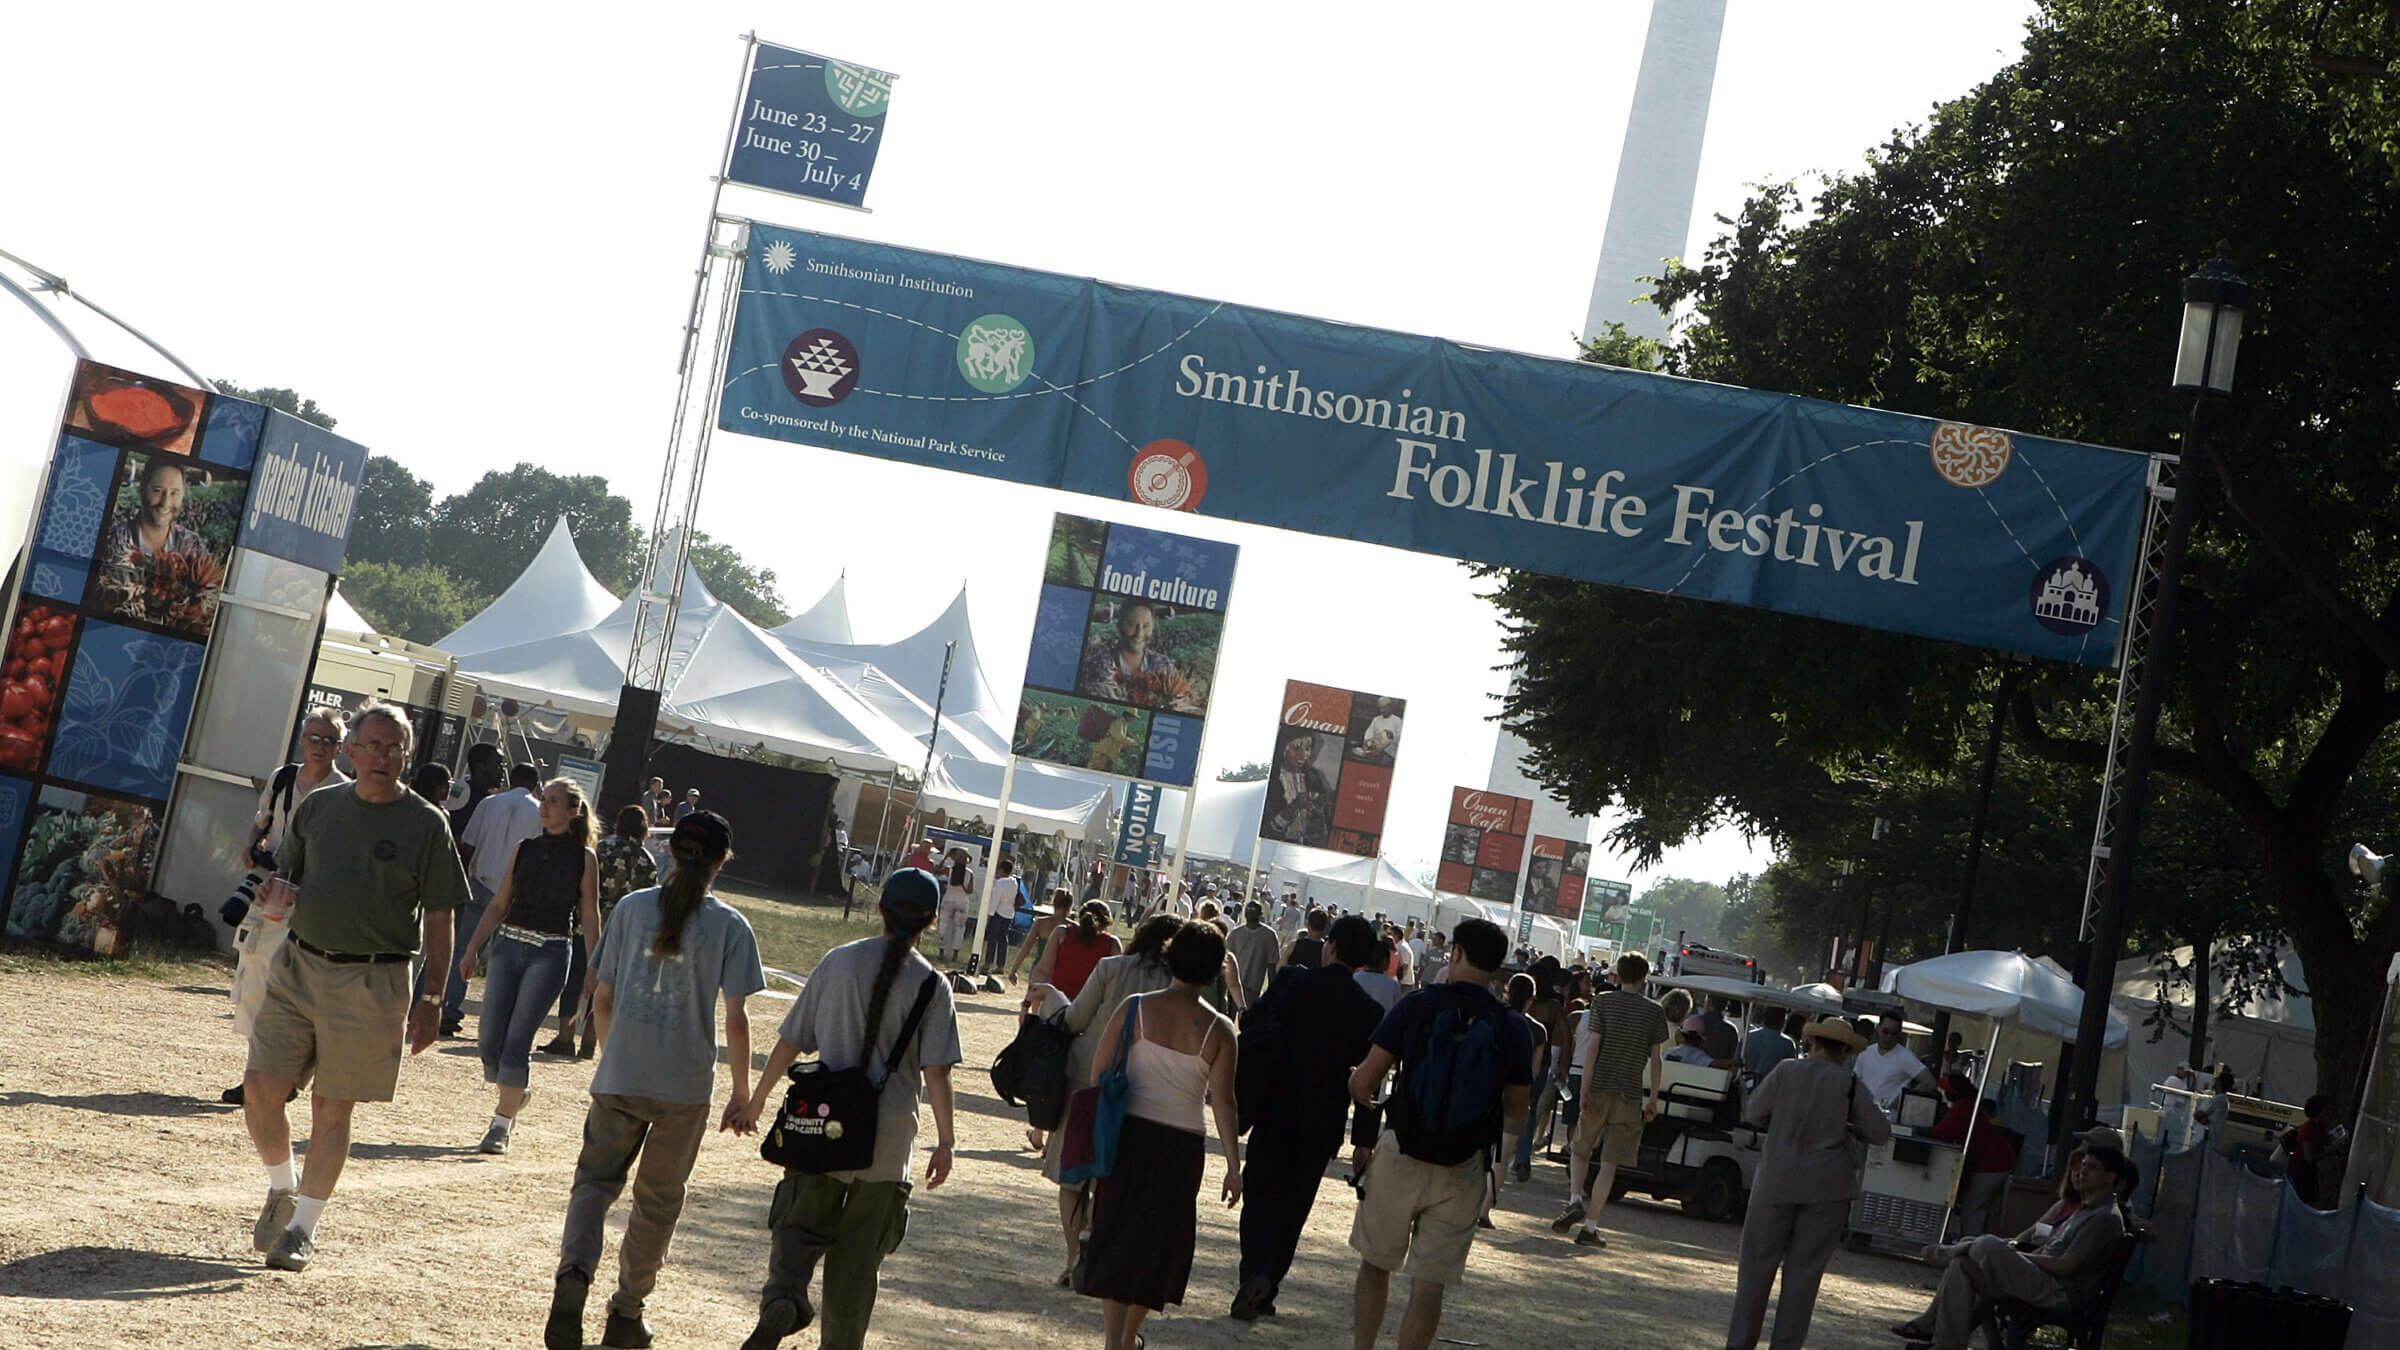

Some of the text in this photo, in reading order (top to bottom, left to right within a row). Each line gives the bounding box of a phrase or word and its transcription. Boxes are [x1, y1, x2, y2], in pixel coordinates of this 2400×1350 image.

[750, 99, 798, 127] June
[802, 112, 827, 133] 23
[847, 123, 875, 144] 27
[743, 126, 792, 154] June
[795, 139, 821, 161] 30
[801, 161, 862, 192] July 4
[806, 258, 974, 298] Smithsonian Institution
[1175, 354, 1467, 442] Smithsonian
[740, 406, 1006, 463] Co-sponsored by the National Park Service
[250, 442, 355, 539] garden kitchen
[1386, 437, 1923, 586] Folklife Festival
[1102, 564, 1218, 610] food culture
[308, 688, 343, 708] HLER
[1284, 701, 1346, 735] Oman
[1463, 791, 1508, 816] Oman
[1469, 811, 1506, 833] Café
[1532, 844, 1564, 861] Oman
